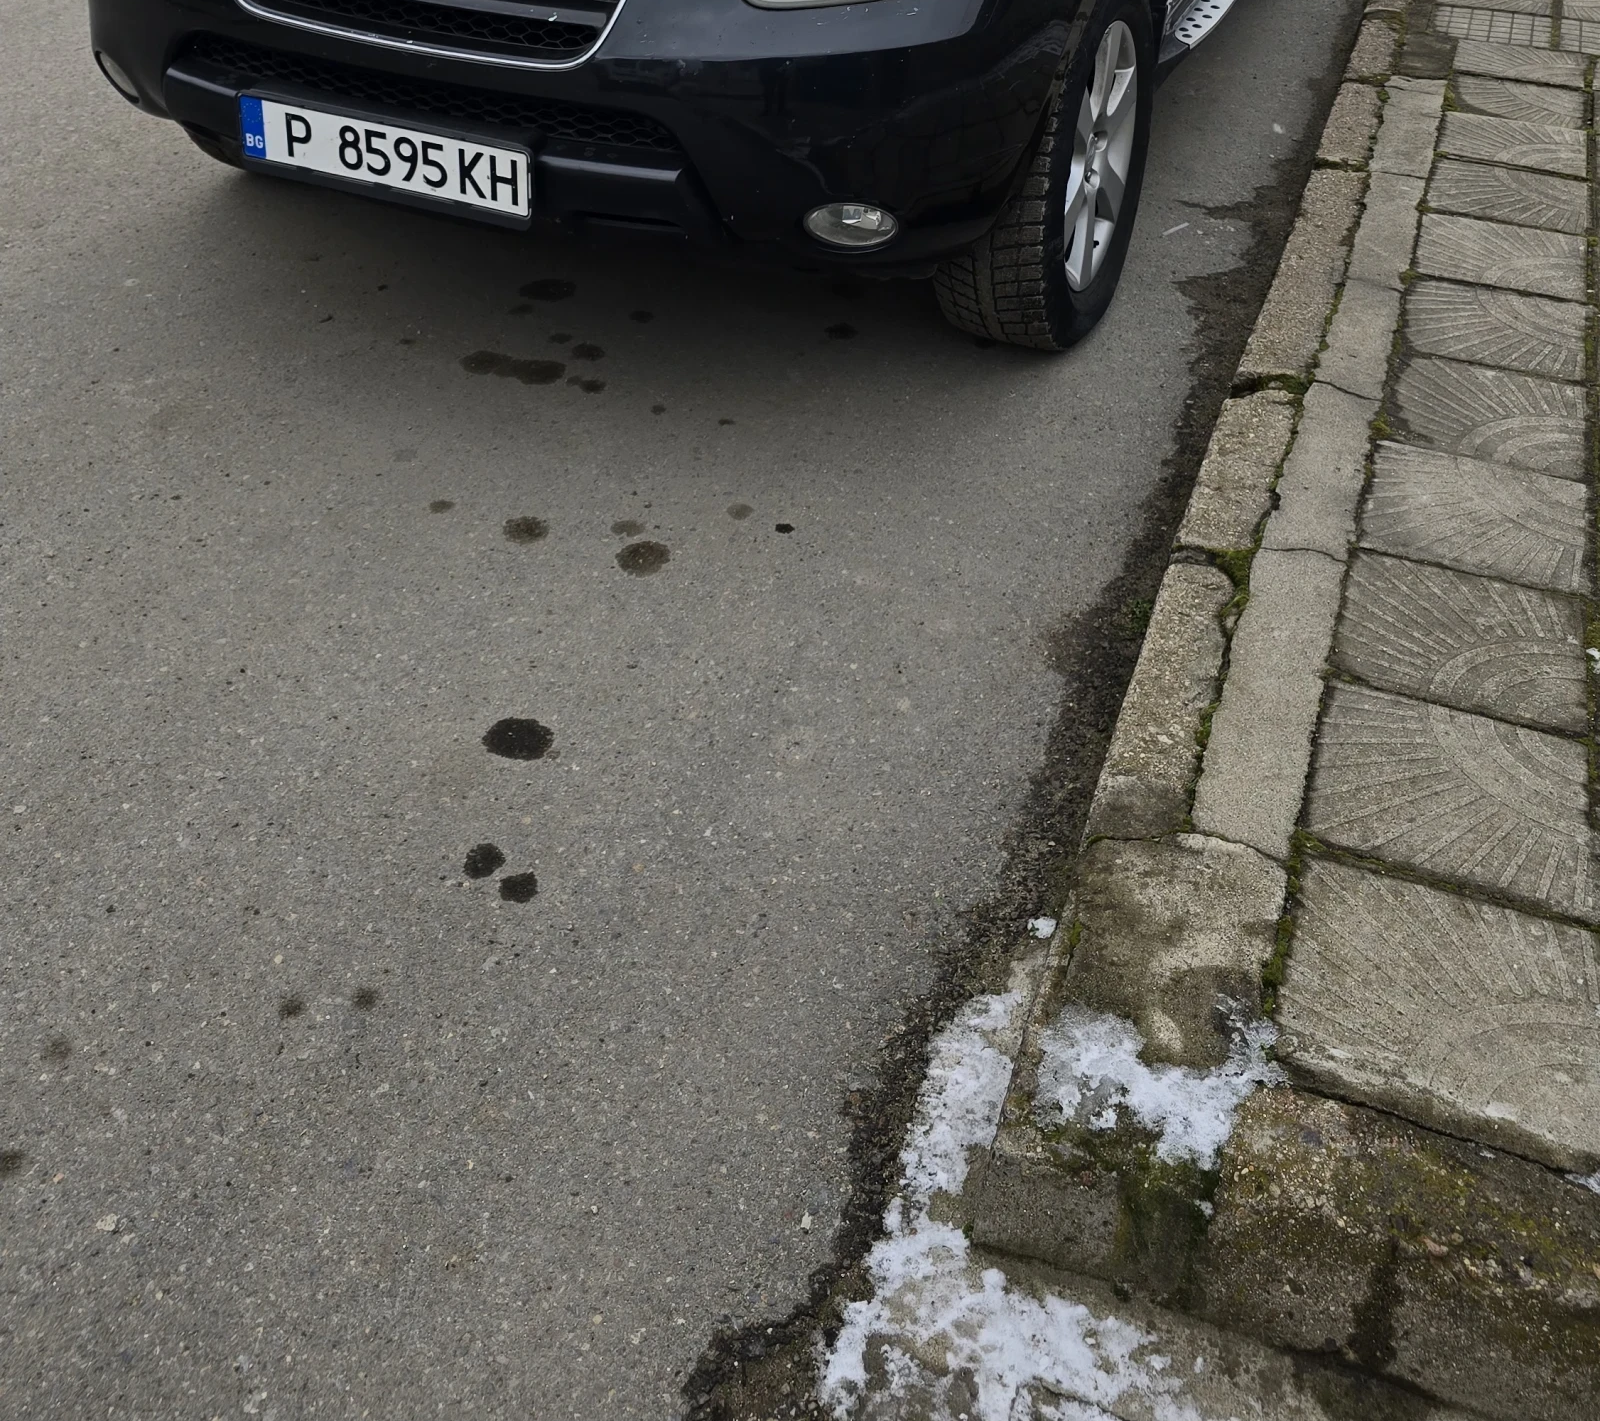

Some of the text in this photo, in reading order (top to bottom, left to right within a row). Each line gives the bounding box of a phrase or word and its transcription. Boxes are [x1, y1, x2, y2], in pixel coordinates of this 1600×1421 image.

[245, 132, 264, 149] BG
[285, 112, 519, 206] P 8595 KH
